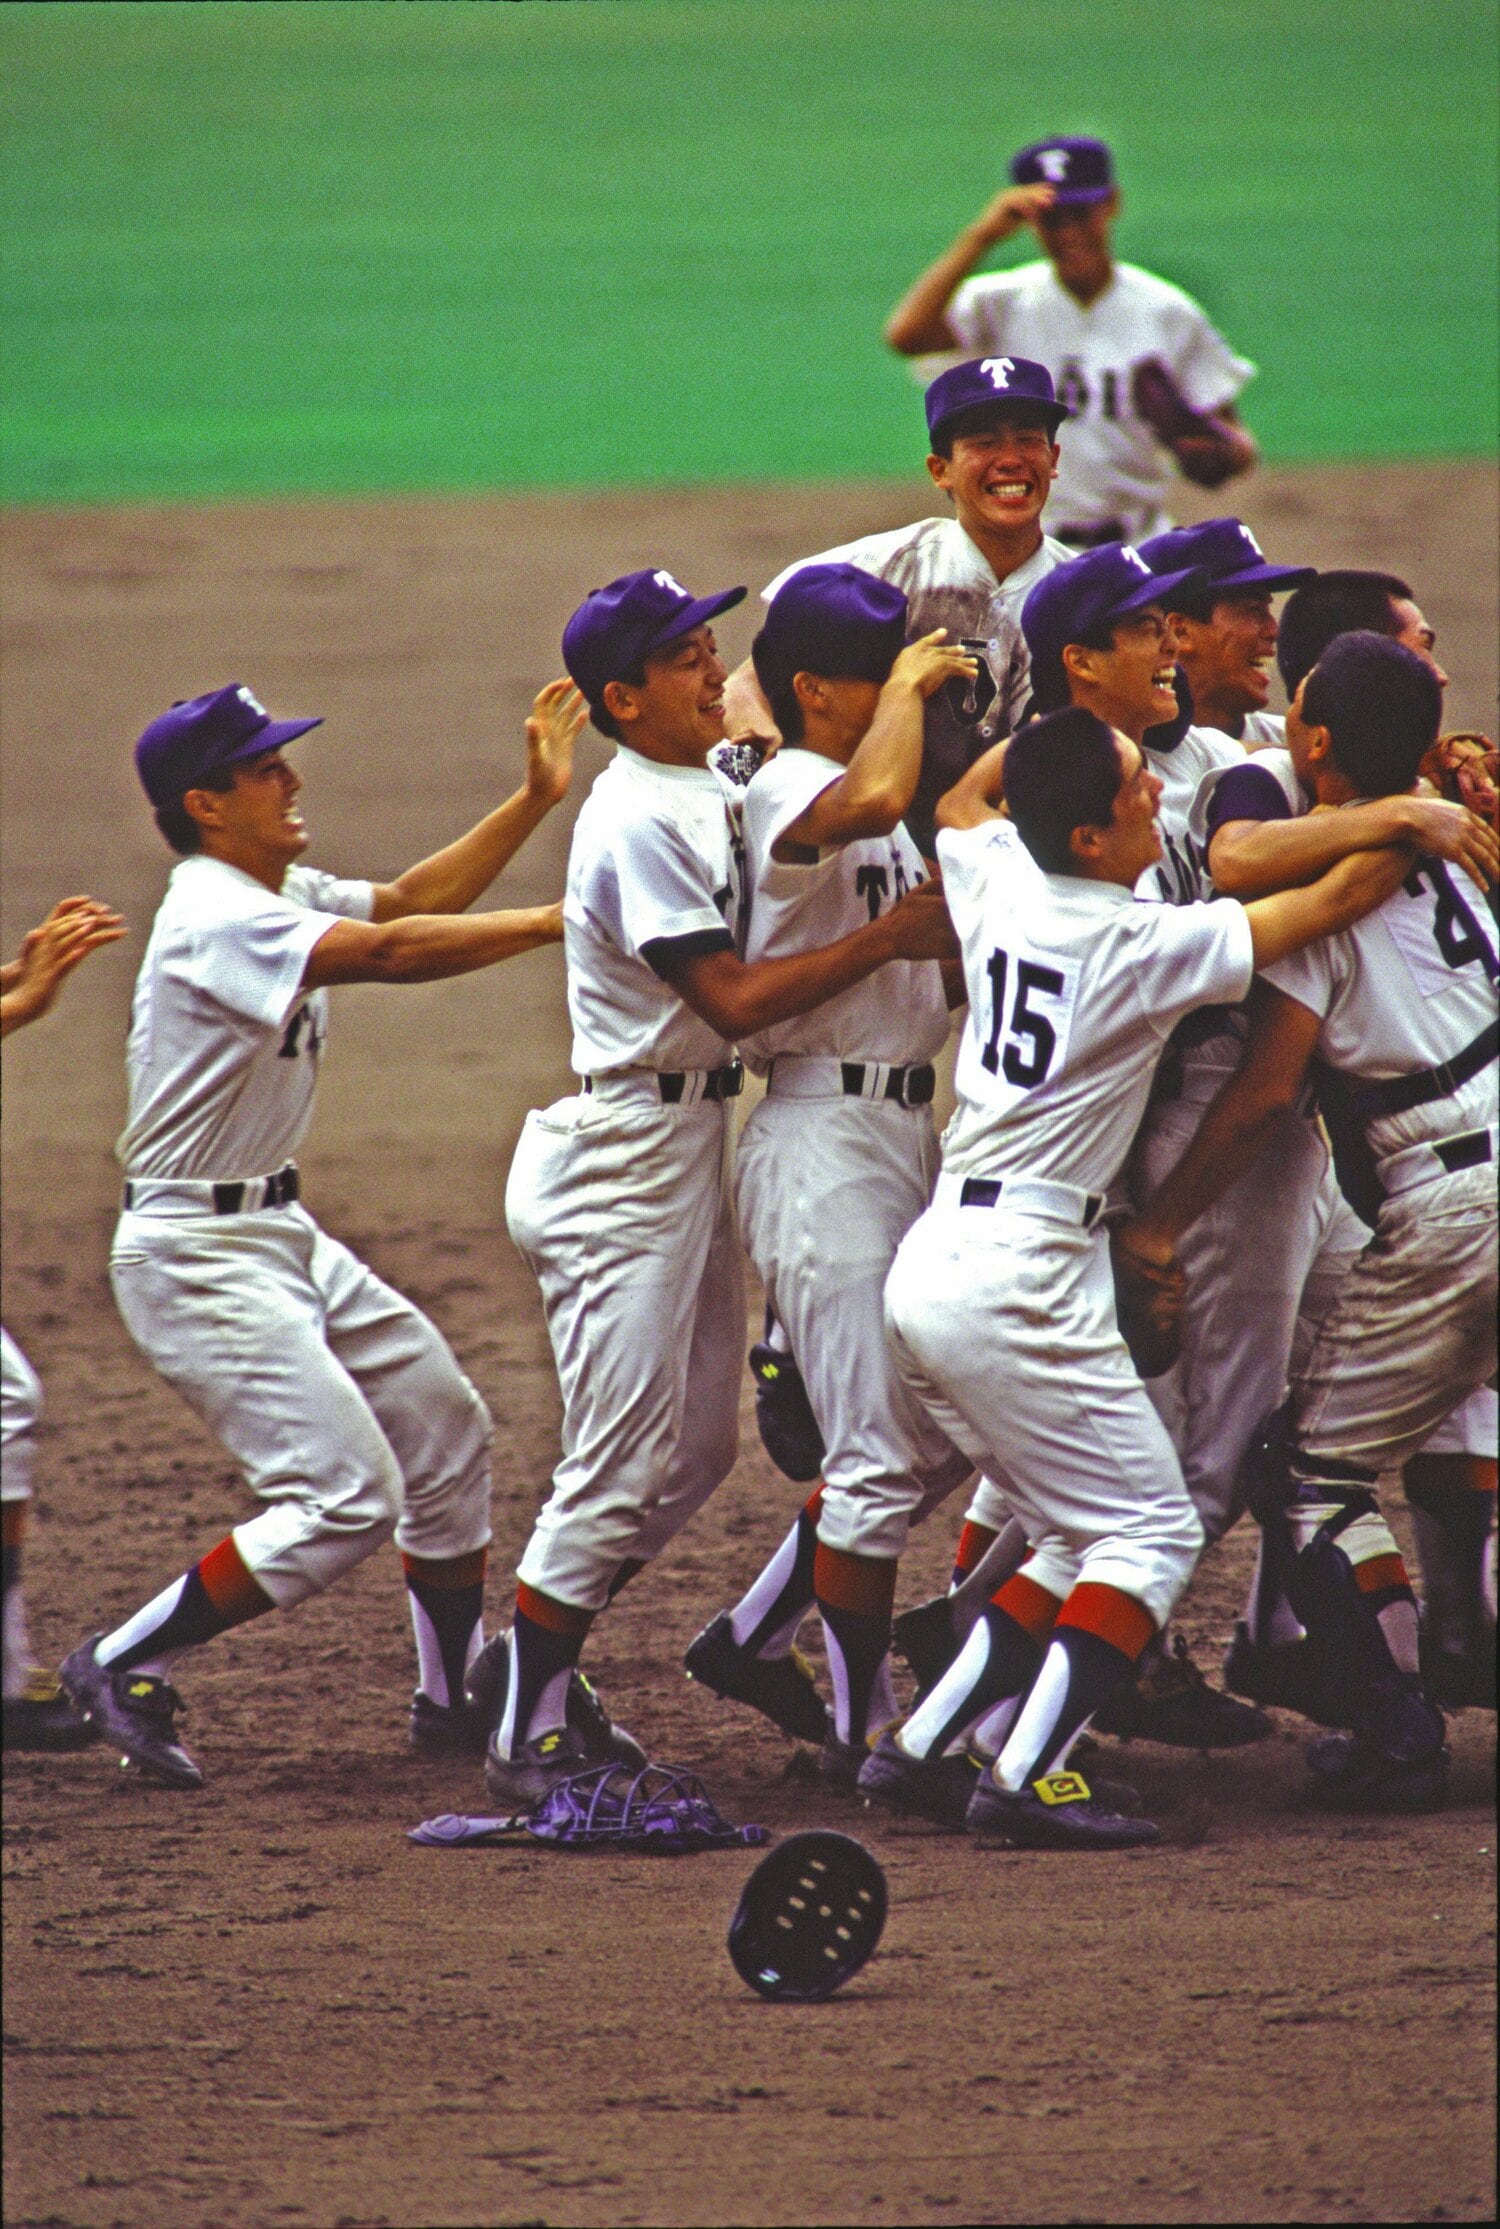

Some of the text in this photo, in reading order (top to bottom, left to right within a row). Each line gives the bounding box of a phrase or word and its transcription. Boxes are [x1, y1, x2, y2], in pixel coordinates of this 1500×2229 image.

[1036, 149, 1070, 182] T
[980, 357, 1015, 389] T
[653, 570, 688, 597] T
[981, 946, 1064, 1090] 15
